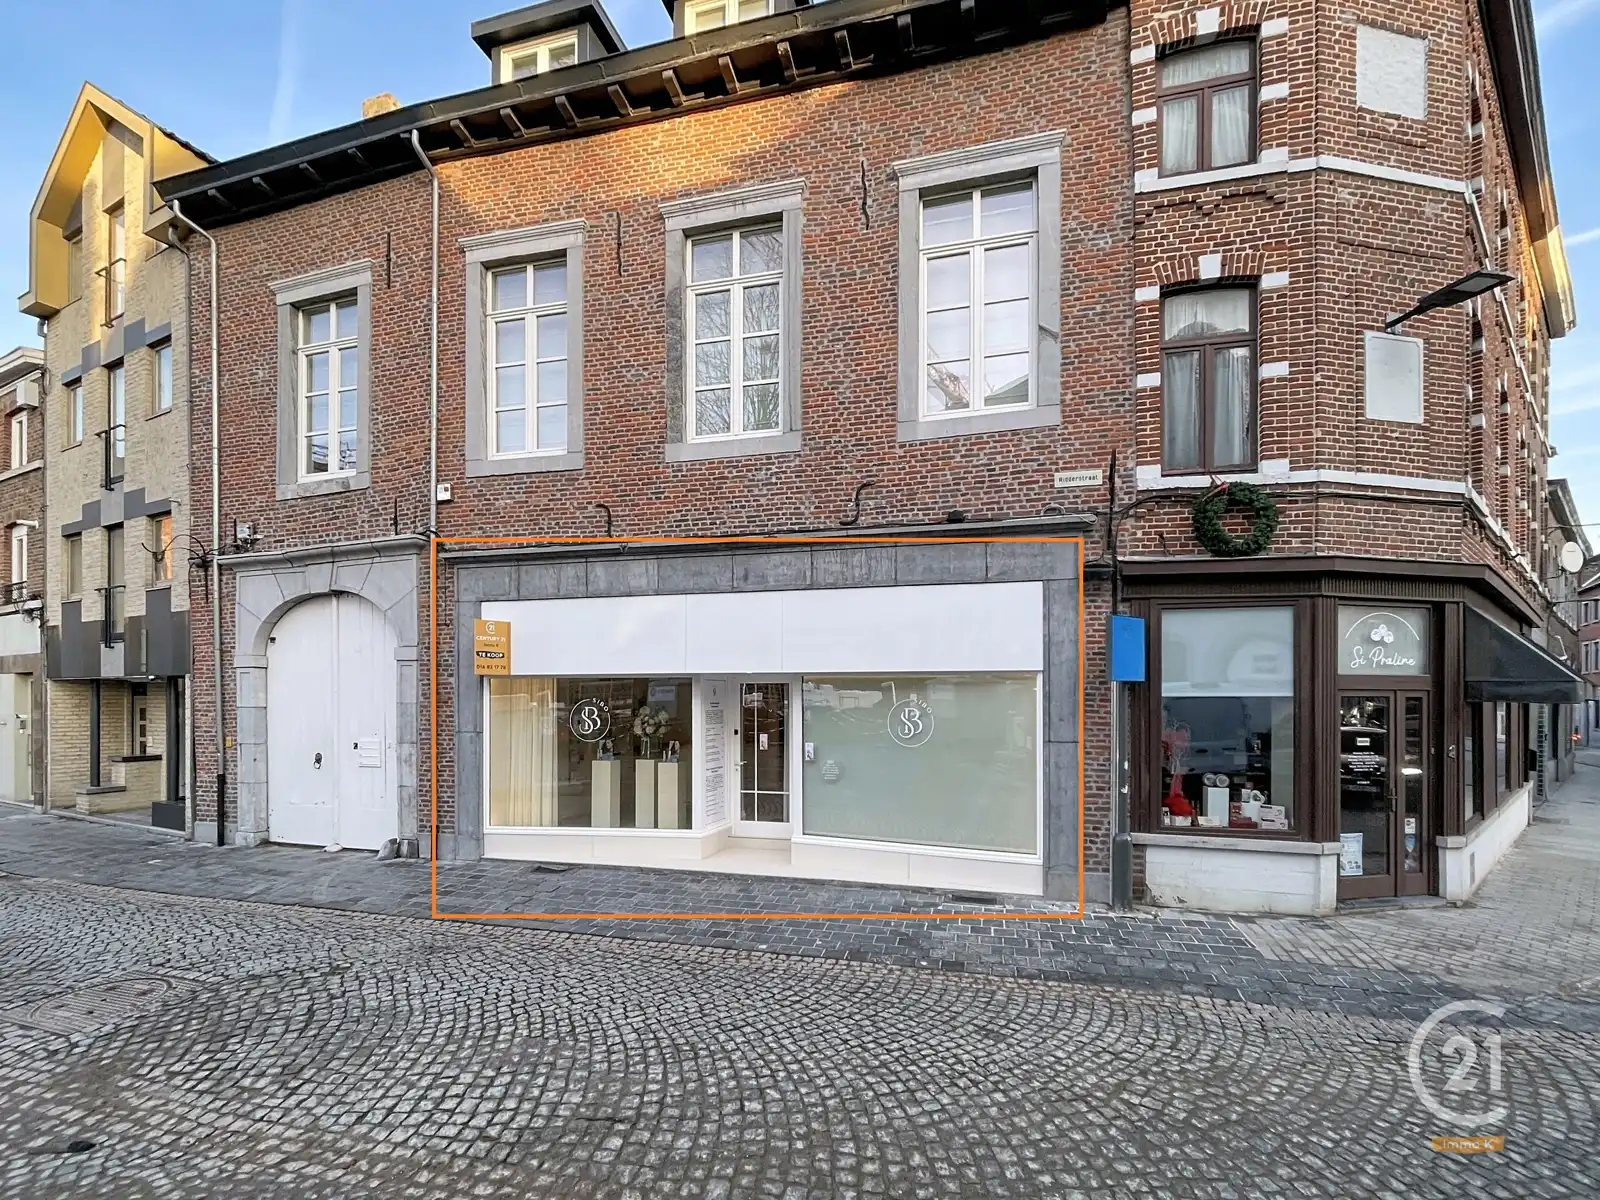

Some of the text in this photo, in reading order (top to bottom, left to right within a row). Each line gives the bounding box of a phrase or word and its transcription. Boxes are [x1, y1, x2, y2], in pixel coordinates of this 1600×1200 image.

[1350, 645, 1416, 669] Si Praline
[592, 697, 609, 712] SIBO
